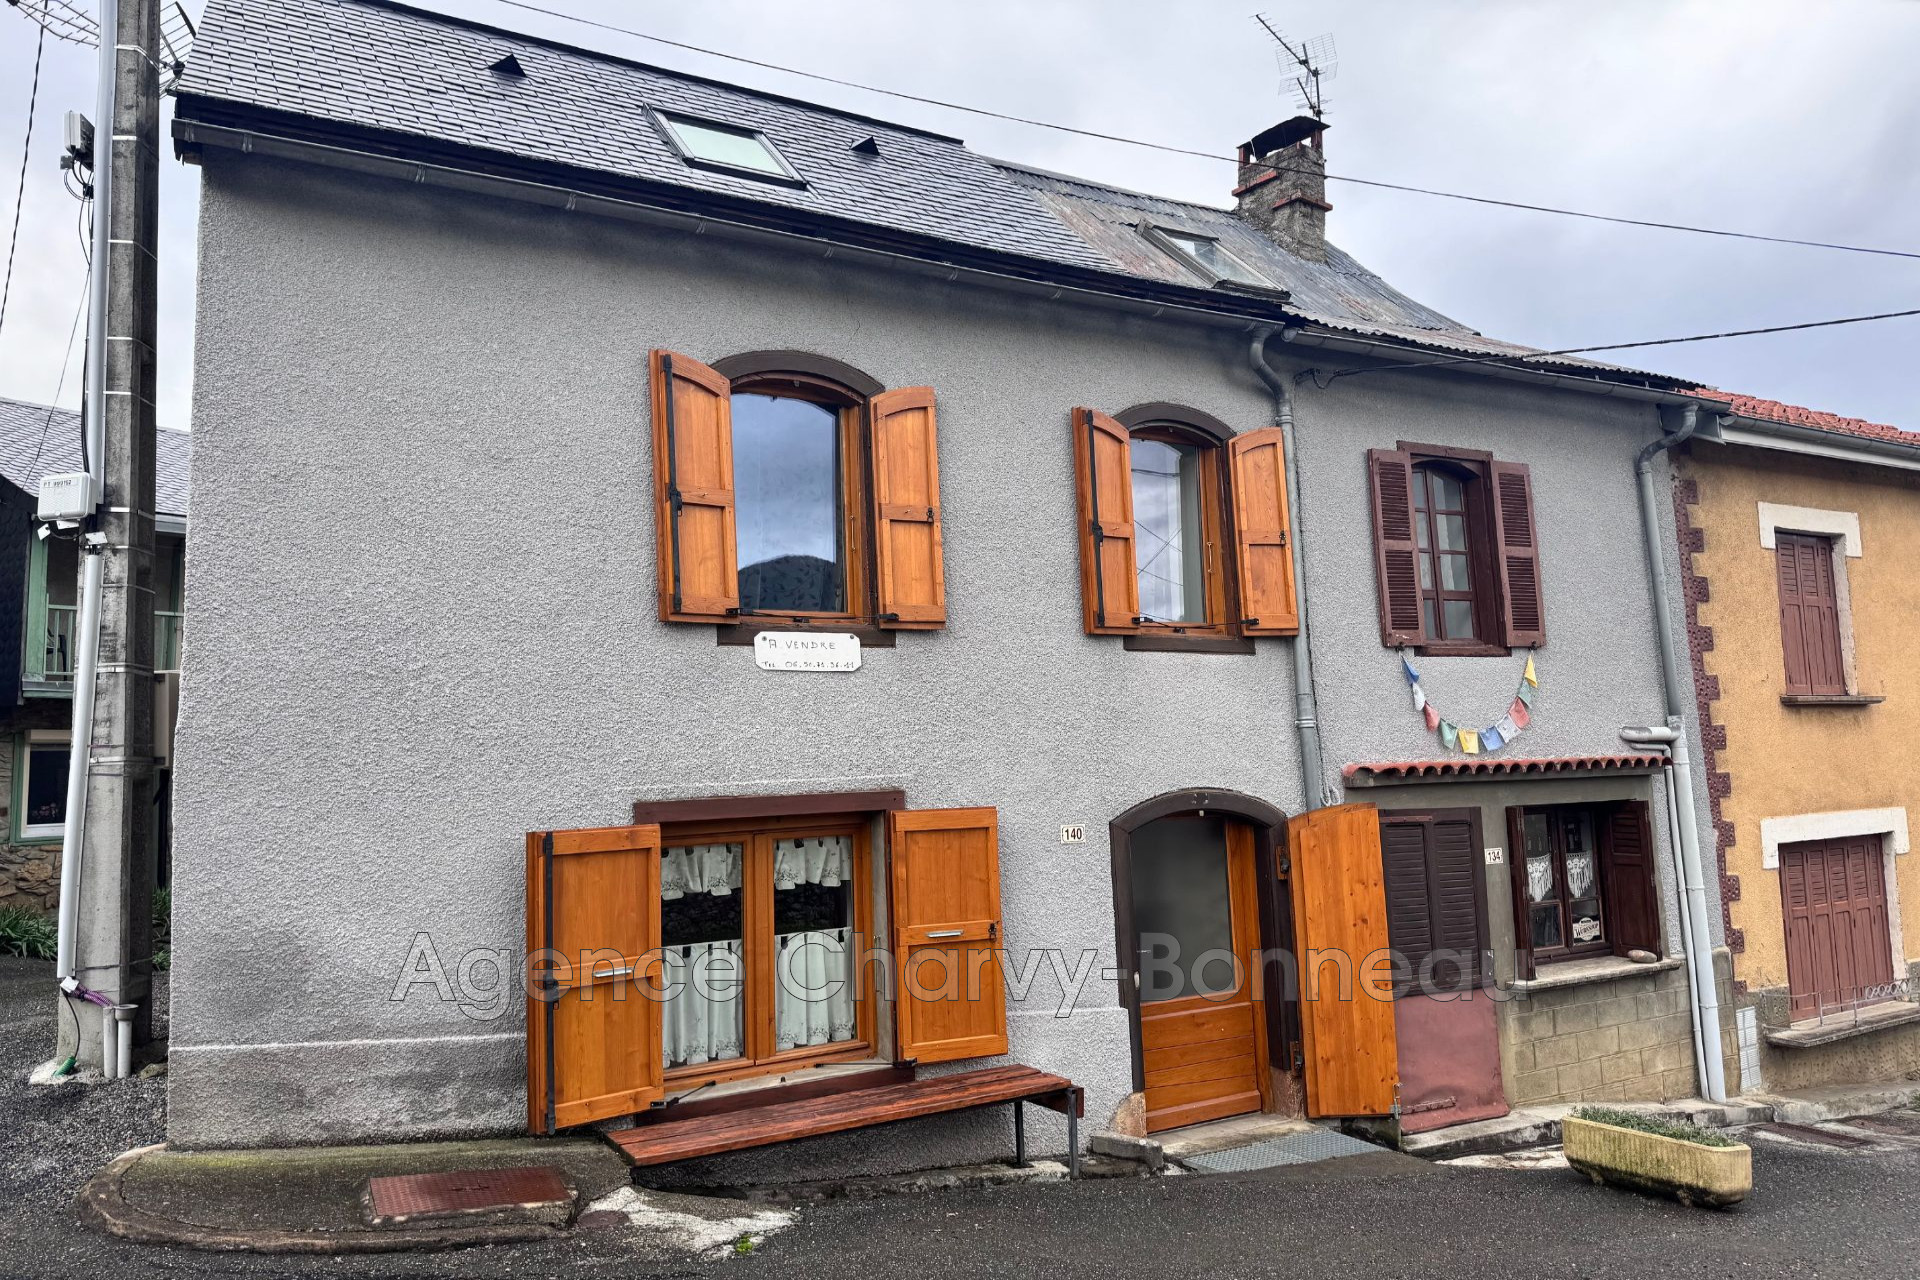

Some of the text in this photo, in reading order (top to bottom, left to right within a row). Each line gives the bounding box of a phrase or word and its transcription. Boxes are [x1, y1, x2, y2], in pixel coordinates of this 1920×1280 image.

[785, 640, 837, 650] VENDRE
[1065, 828, 1082, 840] 140
[1488, 850, 1501, 862] 134
